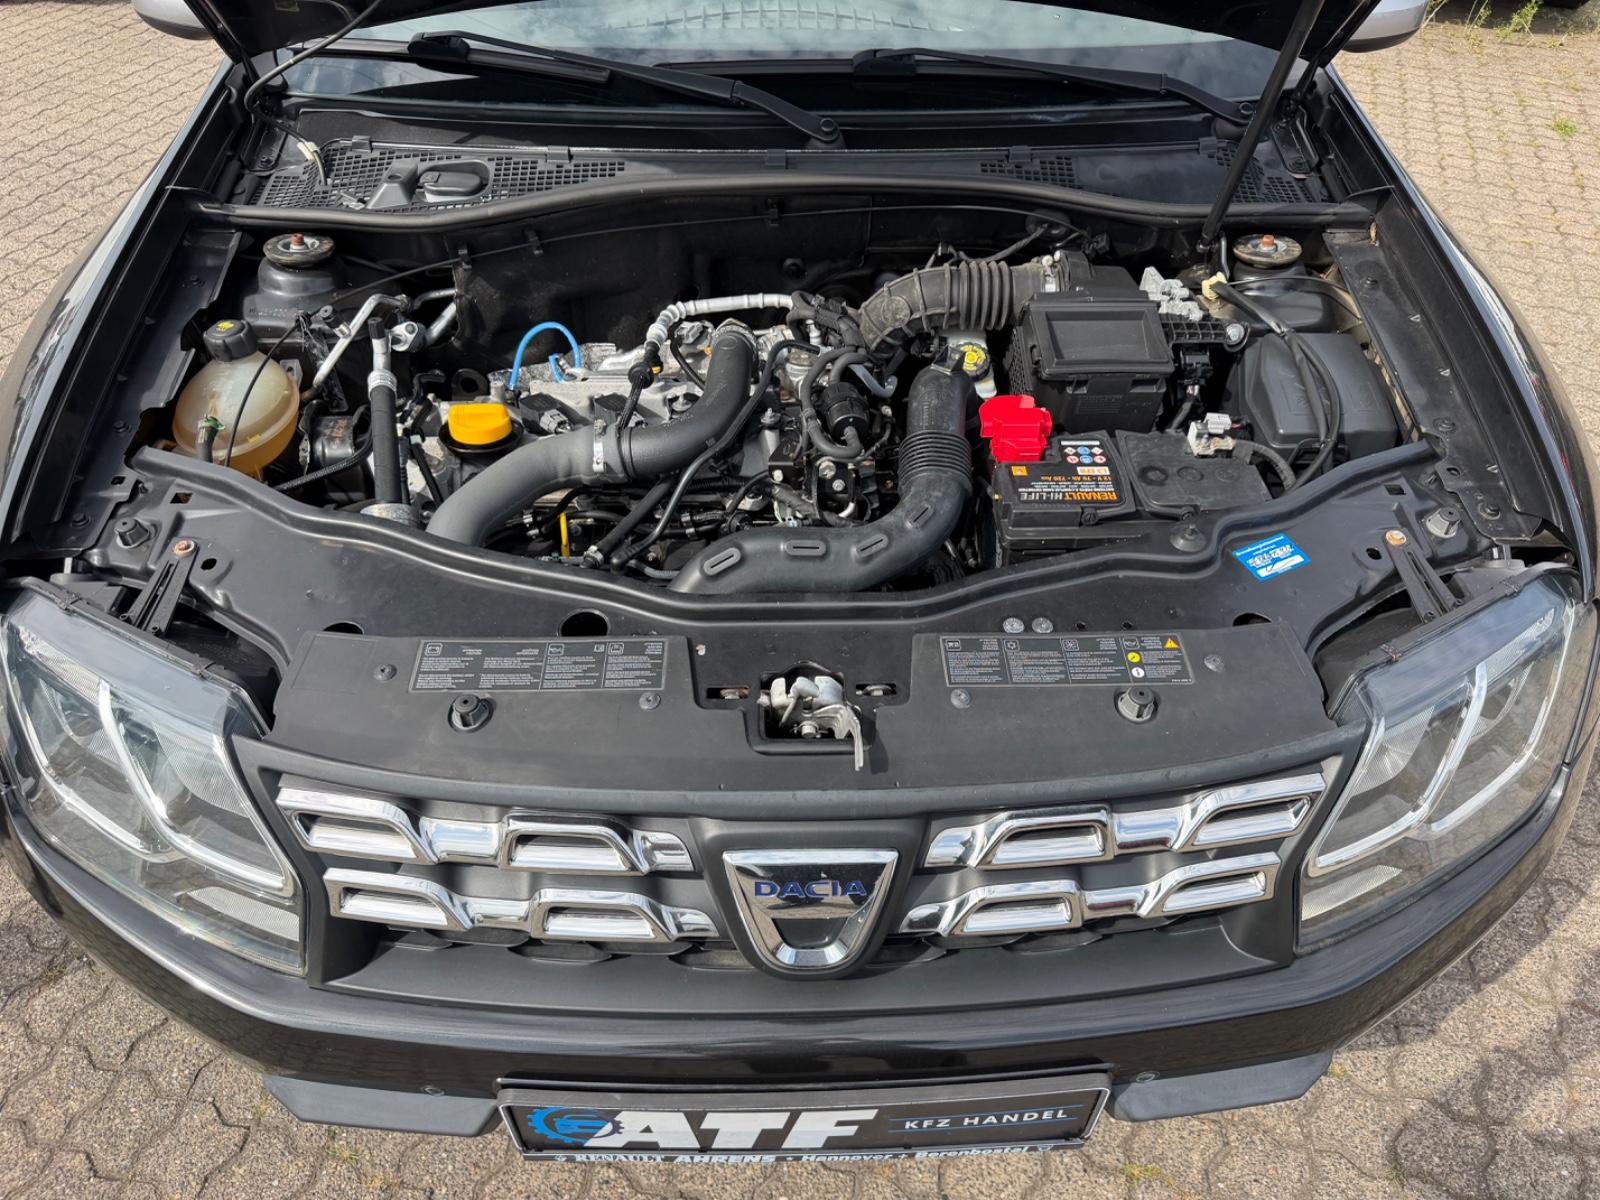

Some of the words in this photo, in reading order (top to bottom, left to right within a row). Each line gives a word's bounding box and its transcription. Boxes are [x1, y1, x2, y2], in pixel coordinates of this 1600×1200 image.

[1020, 492, 1063, 500] HI-LIFE
[1064, 491, 1118, 500] RENAULT
[754, 880, 867, 898] DACIA
[904, 1118, 951, 1129] KFZ
[963, 1109, 1068, 1126] HANDEL
[584, 1109, 879, 1149] ATF
[674, 1154, 777, 1163] AHRENS
[800, 1152, 894, 1163] Hannover
